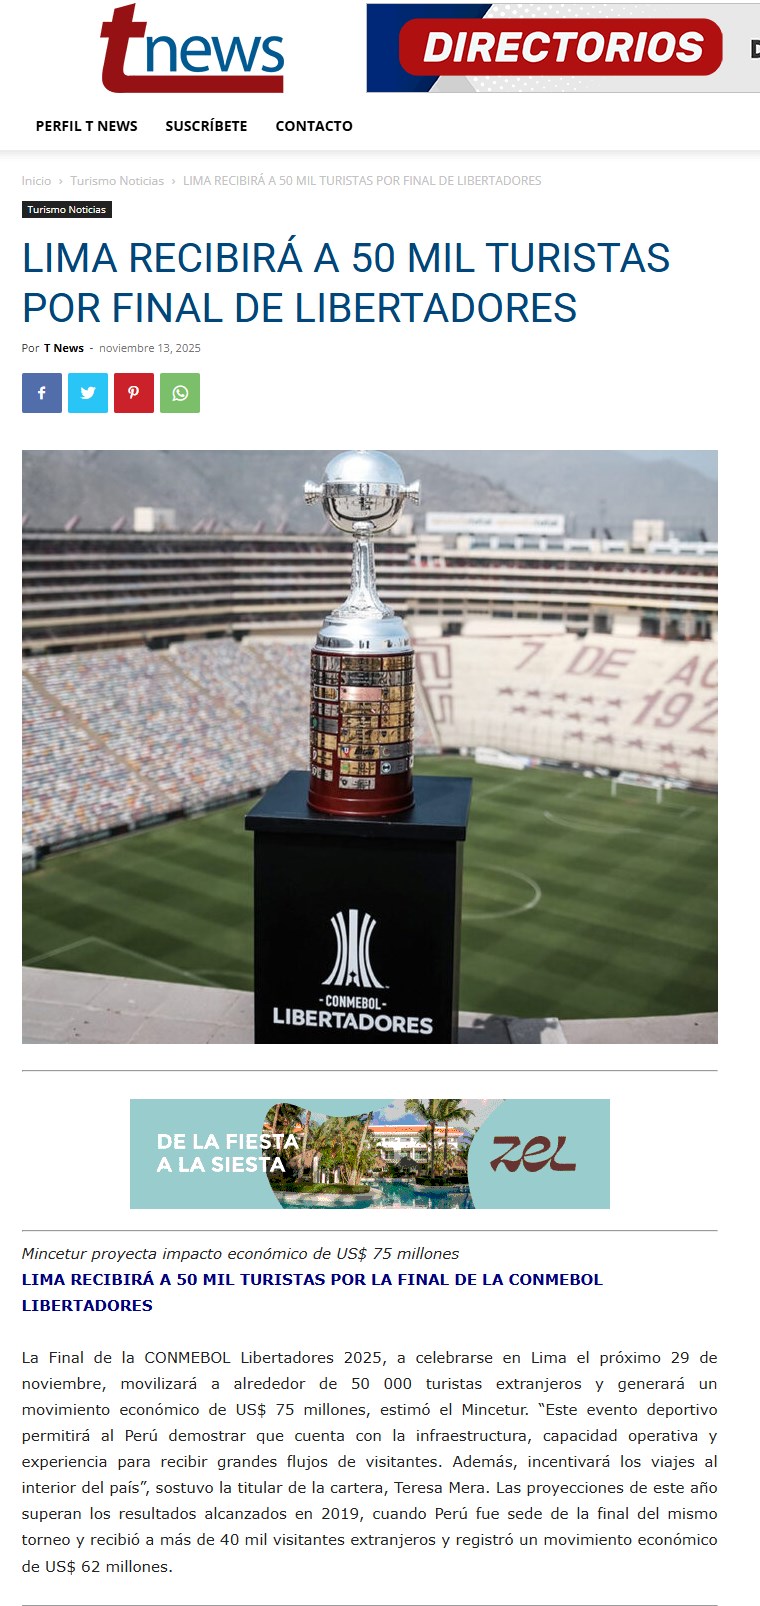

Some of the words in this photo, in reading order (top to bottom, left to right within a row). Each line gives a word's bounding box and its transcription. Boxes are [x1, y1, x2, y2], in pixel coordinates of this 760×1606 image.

[422, 31, 705, 63] DIRECTORIOS
[36, 121, 82, 131] PERFIL
[85, 121, 93, 131] T
[98, 121, 137, 131] NEWS
[166, 118, 247, 131] SUSCRÍBETE
[276, 121, 352, 131] CONTACTO
[23, 176, 50, 185] Inicio
[71, 176, 116, 185] Turismo
[121, 176, 164, 185] Noticias
[184, 176, 211, 185] LIMA
[215, 173, 265, 185] RECIBIRÁ
[269, 176, 276, 185] A
[280, 176, 292, 185] 50
[297, 176, 316, 185] MIL
[320, 176, 372, 185] TURISTAS
[377, 176, 400, 185] POR
[404, 176, 435, 185] FINAL
[440, 176, 453, 185] DE
[458, 176, 541, 185] LIBERTADORES
[25, 243, 117, 272] LIMA
[131, 235, 303, 272] RECIBIRÁ
[314, 243, 339, 272] A
[353, 243, 394, 272] 50
[410, 243, 475, 272] MIL
[486, 243, 669, 272] TURISTAS
[25, 293, 100, 322] POR
[114, 293, 223, 322] FINAL
[237, 293, 283, 322] DE
[297, 293, 576, 322] LIBERTADORES
[22, 344, 39, 352] Por
[44, 344, 51, 352] T
[54, 344, 84, 352] News
[100, 344, 154, 352] noviembre
[158, 344, 172, 354] 13,
[176, 344, 200, 352] 2025
[566, 646, 635, 678] DE
[273, 1007, 434, 1035] LIBERTADORES
[156, 1133, 186, 1150] DE
[193, 1133, 218, 1150] LA
[225, 1133, 300, 1150] FIESTA
[156, 1156, 173, 1173] A
[178, 1156, 204, 1173] LA
[211, 1156, 286, 1173] SIESTA
[22, 1248, 87, 1259] Mincetur
[91, 1249, 156, 1262] proyecta
[163, 1248, 222, 1262] impacto
[228, 1248, 307, 1259] económico
[313, 1247, 331, 1259] de
[337, 1247, 367, 1262] US$
[373, 1248, 392, 1259] 75
[397, 1247, 459, 1259] millones
[23, 1274, 65, 1285] LIMA
[71, 1271, 154, 1285] RECIBIRÁ
[160, 1274, 171, 1285] A
[177, 1274, 197, 1285] 50
[204, 1274, 235, 1285] MIL
[240, 1274, 325, 1285] TURISTAS
[331, 1274, 366, 1285] POR
[372, 1274, 392, 1285] LA
[398, 1274, 449, 1285] FINAL
[455, 1274, 477, 1285] DE
[483, 1274, 504, 1285] LA
[509, 1274, 603, 1285] CONMEBOL
[23, 1300, 152, 1311] LIBERTADORES
[23, 1352, 38, 1363] La
[50, 1351, 83, 1363] Final
[94, 1351, 111, 1363] de
[122, 1351, 134, 1363] la
[145, 1352, 231, 1363] CONMEBOL
[242, 1351, 333, 1363] Libertadores
[345, 1352, 386, 1366] 2025,
[398, 1355, 405, 1363] a
[416, 1351, 492, 1363] celebrarse
[503, 1355, 520, 1363] en
[532, 1352, 566, 1363] Lima
[577, 1351, 589, 1363] el
[600, 1351, 660, 1366] próximo
[672, 1352, 689, 1363] 29
[700, 1351, 717, 1363] de
[22, 1377, 106, 1392] noviembre,
[121, 1377, 196, 1389] movilizará
[212, 1381, 219, 1389] a
[234, 1377, 306, 1389] alrededor
[319, 1377, 337, 1389] de
[352, 1378, 369, 1389] 50
[384, 1378, 411, 1389] 000
[426, 1378, 482, 1389] turistas
[496, 1378, 581, 1392] extranjeros
[595, 1381, 604, 1392] y
[618, 1377, 684, 1392] generará
[700, 1381, 717, 1389] un
[23, 1404, 110, 1415] movimiento
[120, 1403, 199, 1415] económico
[209, 1403, 226, 1415] de
[236, 1403, 266, 1418] US$
[276, 1404, 294, 1415] 75
[304, 1403, 370, 1418] millones,
[380, 1403, 430, 1415] estimó
[440, 1403, 452, 1415] el
[463, 1404, 528, 1415] Mincetur.
[587, 1405, 637, 1415] evento
[647, 1403, 717, 1418] deportivo
[22, 1482, 76, 1493] interior
[82, 1481, 103, 1493] del
[156, 1483, 213, 1493] sostuvo
[220, 1481, 231, 1493] la
[238, 1481, 283, 1493] titular
[288, 1481, 306, 1493] de
[312, 1481, 324, 1493] la
[331, 1483, 388, 1496] cartera,
[394, 1482, 442, 1493] Teresa
[450, 1482, 489, 1493] Mera.
[497, 1482, 521, 1493] Las
[527, 1482, 624, 1496] proyecciones
[630, 1481, 647, 1493] de
[654, 1483, 684, 1493] este
[691, 1482, 717, 1493] año
[22, 1535, 70, 1545] torneo
[76, 1537, 84, 1548] y
[91, 1533, 140, 1545] recibió
[146, 1537, 153, 1545] a
[161, 1533, 191, 1545] más
[197, 1533, 214, 1545] de
[220, 1534, 239, 1545] 40
[246, 1533, 266, 1545] mil
[273, 1534, 344, 1545] visitantes
[351, 1534, 435, 1548] extranjeros
[442, 1537, 450, 1548] y
[456, 1533, 513, 1548] registró
[520, 1537, 537, 1545] un
[544, 1534, 632, 1545] movimiento
[638, 1533, 717, 1545] económico
[22, 1560, 39, 1572] de
[46, 1560, 75, 1575] US$
[82, 1561, 100, 1572] 62
[107, 1560, 172, 1572] millones.
